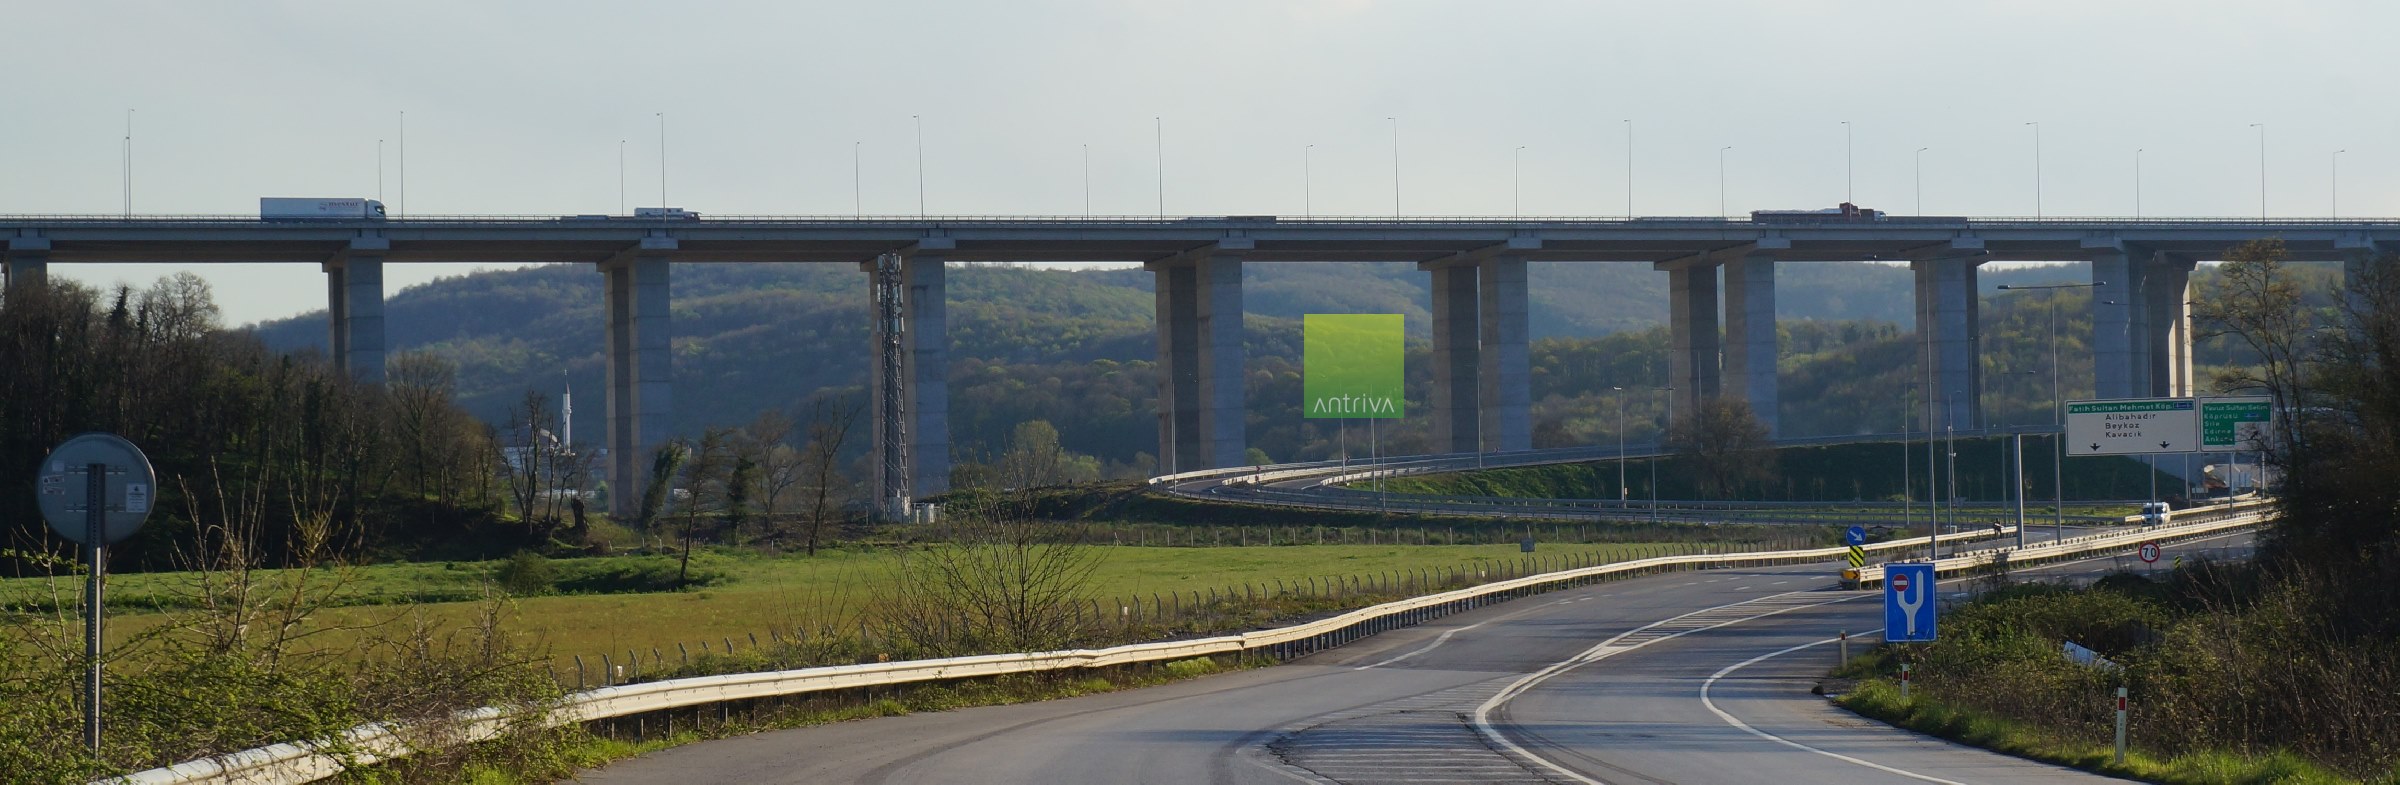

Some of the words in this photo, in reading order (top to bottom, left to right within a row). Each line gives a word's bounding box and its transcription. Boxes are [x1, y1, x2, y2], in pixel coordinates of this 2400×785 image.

[2091, 404, 2118, 412] Sultan
[2119, 403, 2154, 411] Mehmet
[2105, 422, 2140, 430] Beykoz
[2142, 547, 2157, 558] 70
